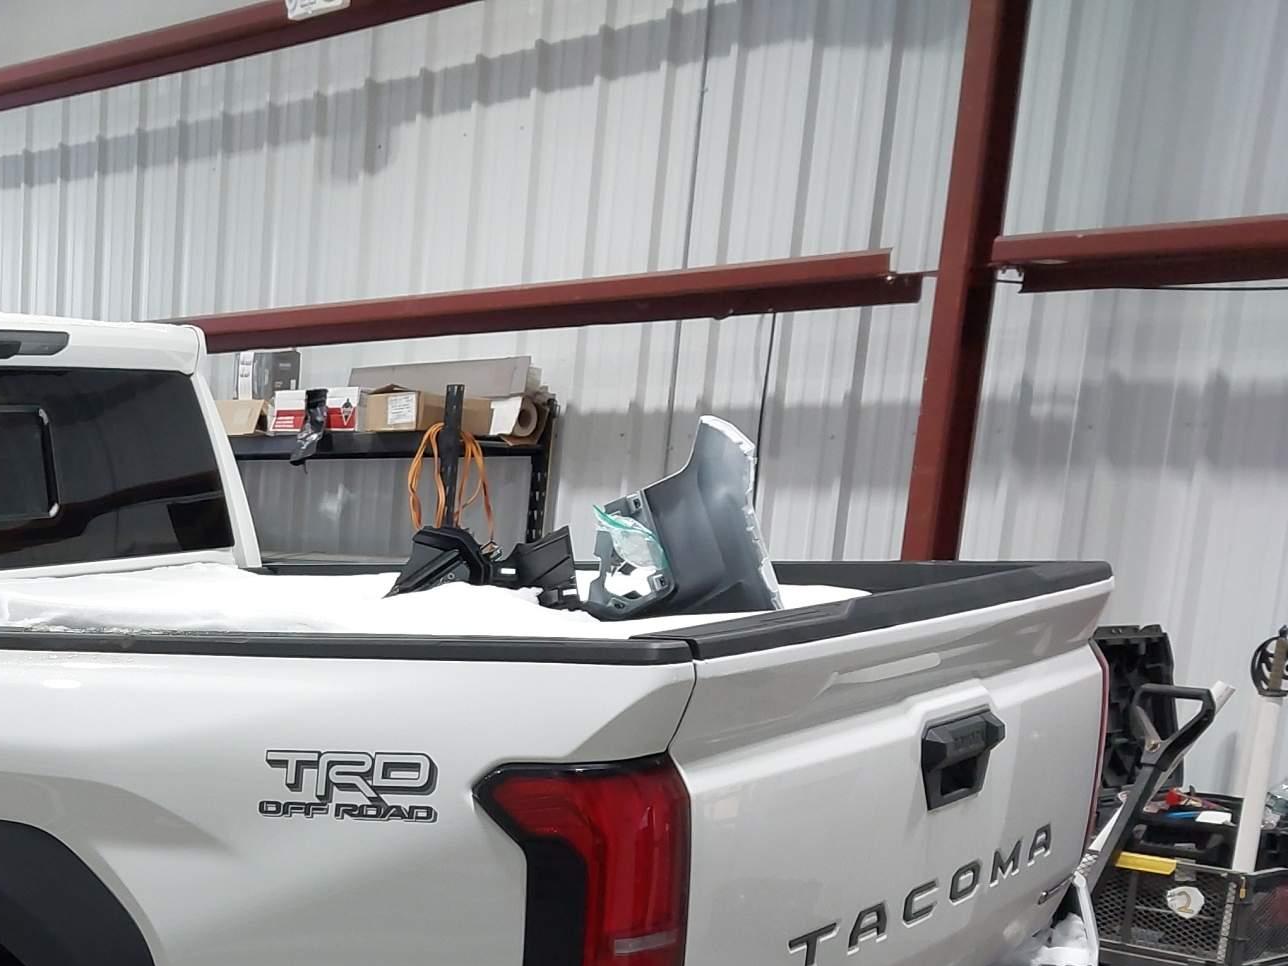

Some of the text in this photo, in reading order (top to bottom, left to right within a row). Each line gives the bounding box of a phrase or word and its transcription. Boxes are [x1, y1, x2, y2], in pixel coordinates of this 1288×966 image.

[264, 750, 438, 804] TRD
[259, 800, 438, 823] OFF ROAD
